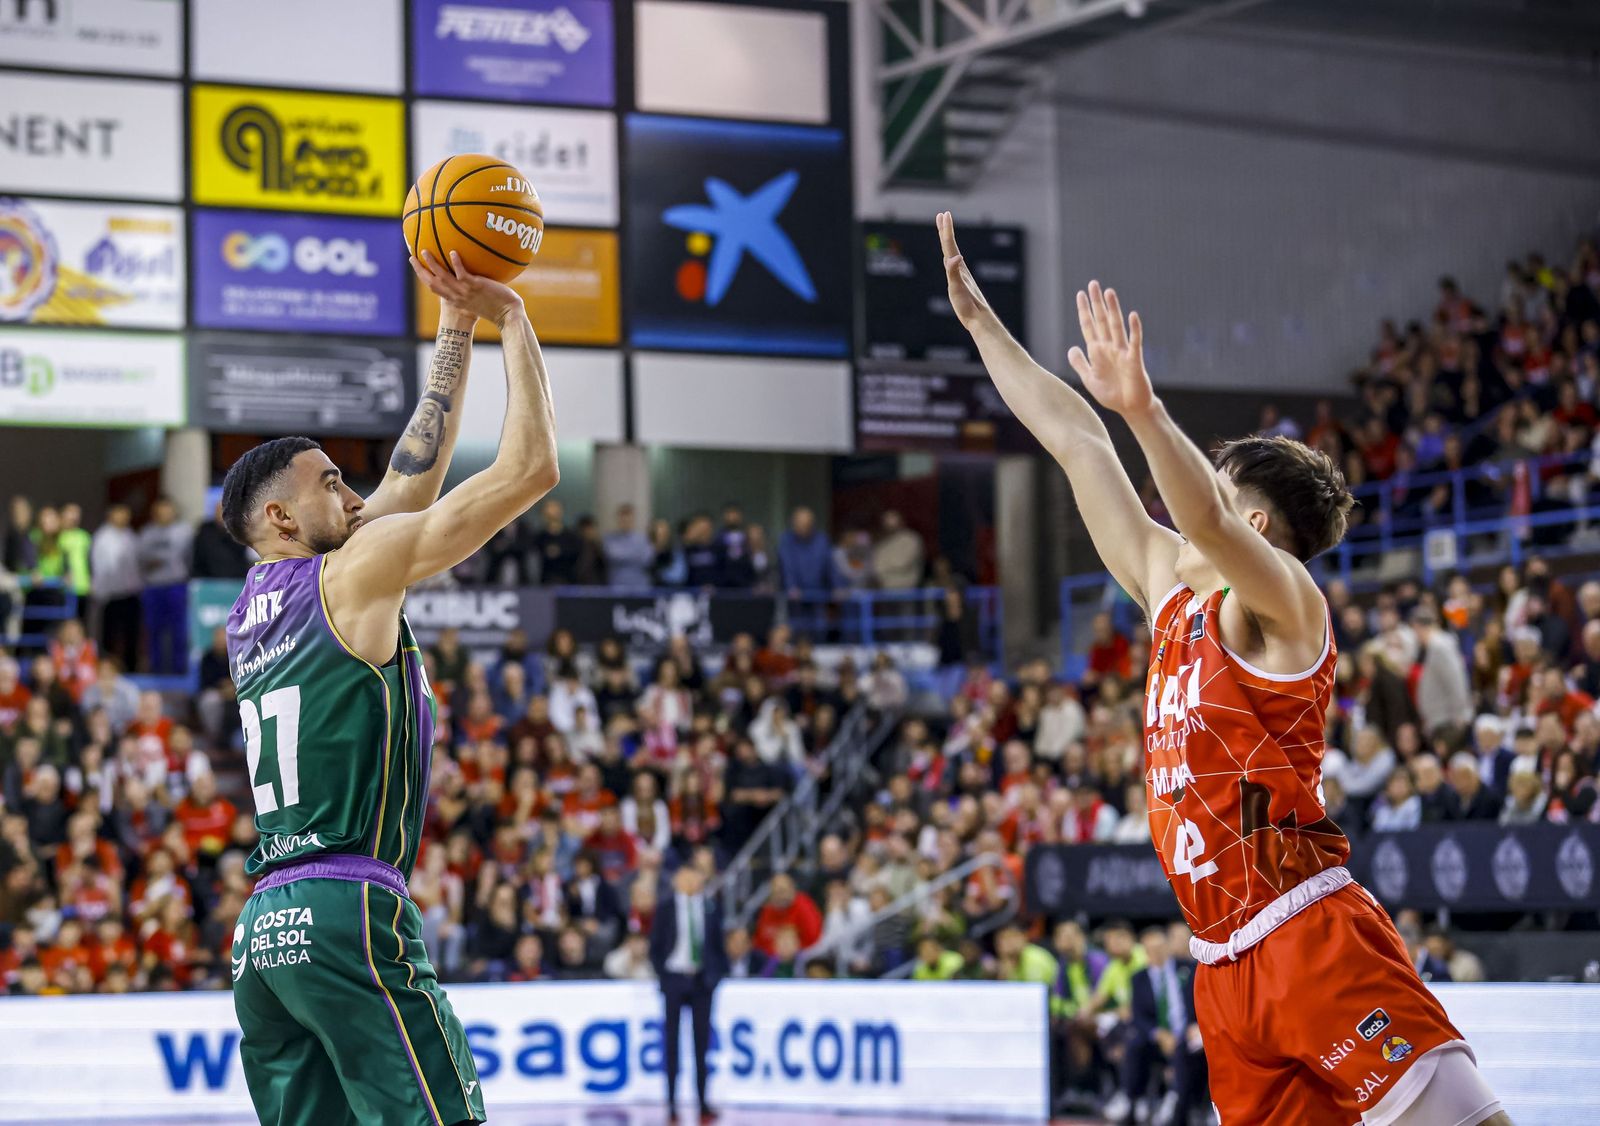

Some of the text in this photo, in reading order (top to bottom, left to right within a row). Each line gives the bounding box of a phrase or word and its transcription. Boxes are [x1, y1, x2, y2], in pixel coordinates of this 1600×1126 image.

[295, 235, 379, 277] GOL
[253, 907, 314, 934] COSTA
[251, 929, 312, 953] DEL SOL
[252, 948, 312, 971] MÁLAGA
[1364, 1020, 1384, 1037] acb
